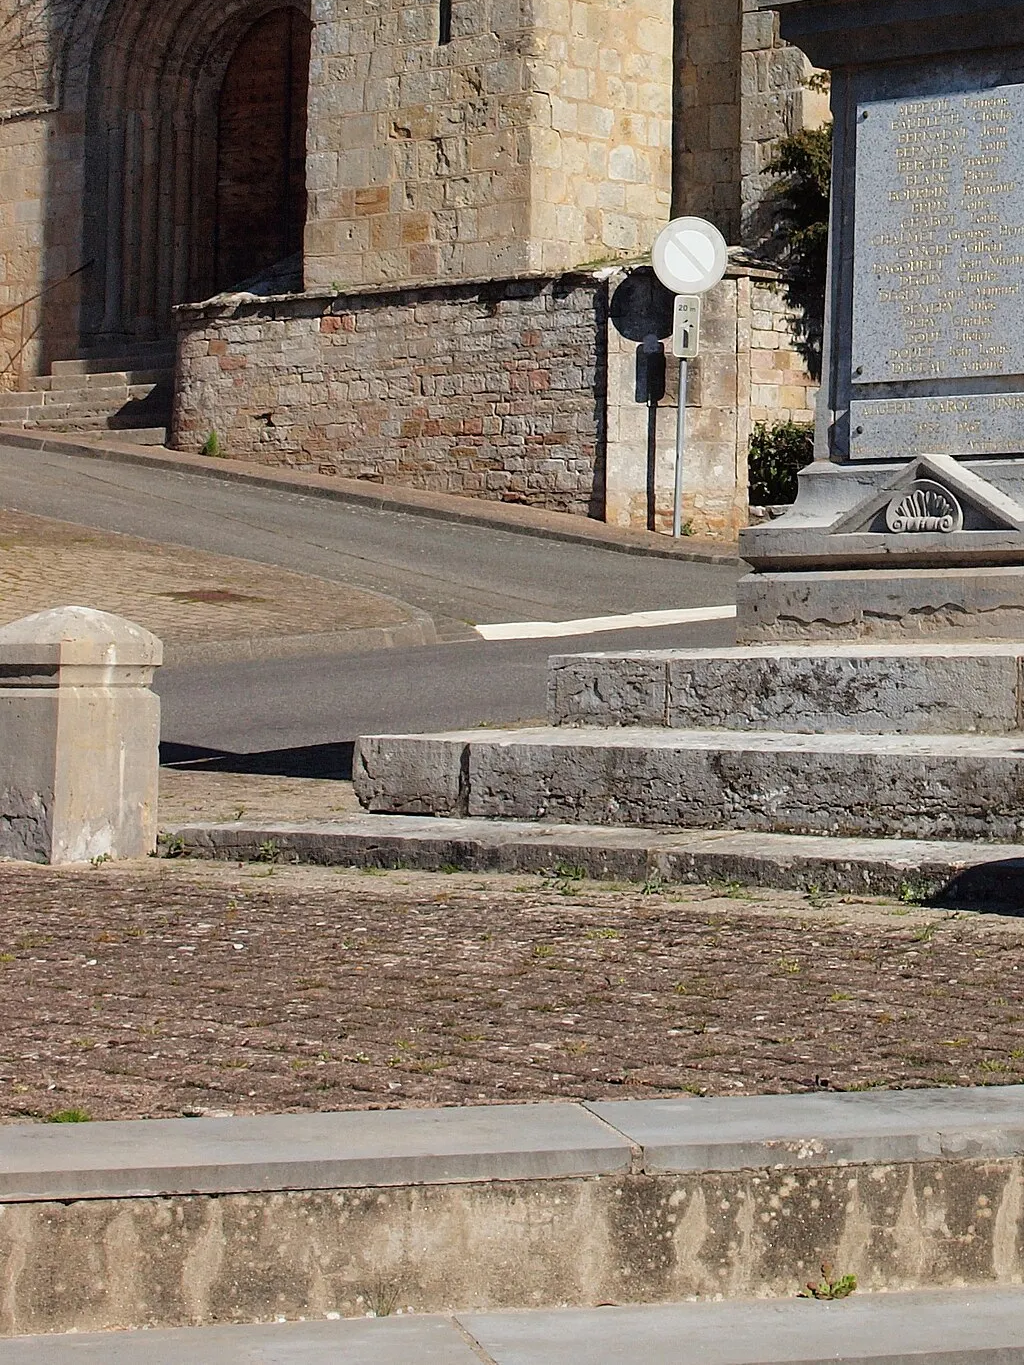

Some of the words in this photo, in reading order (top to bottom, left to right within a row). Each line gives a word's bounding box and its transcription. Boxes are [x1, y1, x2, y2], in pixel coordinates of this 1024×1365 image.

[981, 125, 1008, 136] Jean
[906, 173, 950, 186] BLANC
[888, 187, 950, 202] BOURDIN
[911, 201, 948, 214] BRUN
[678, 304, 688, 312] 20
[925, 399, 975, 414] MAROC
